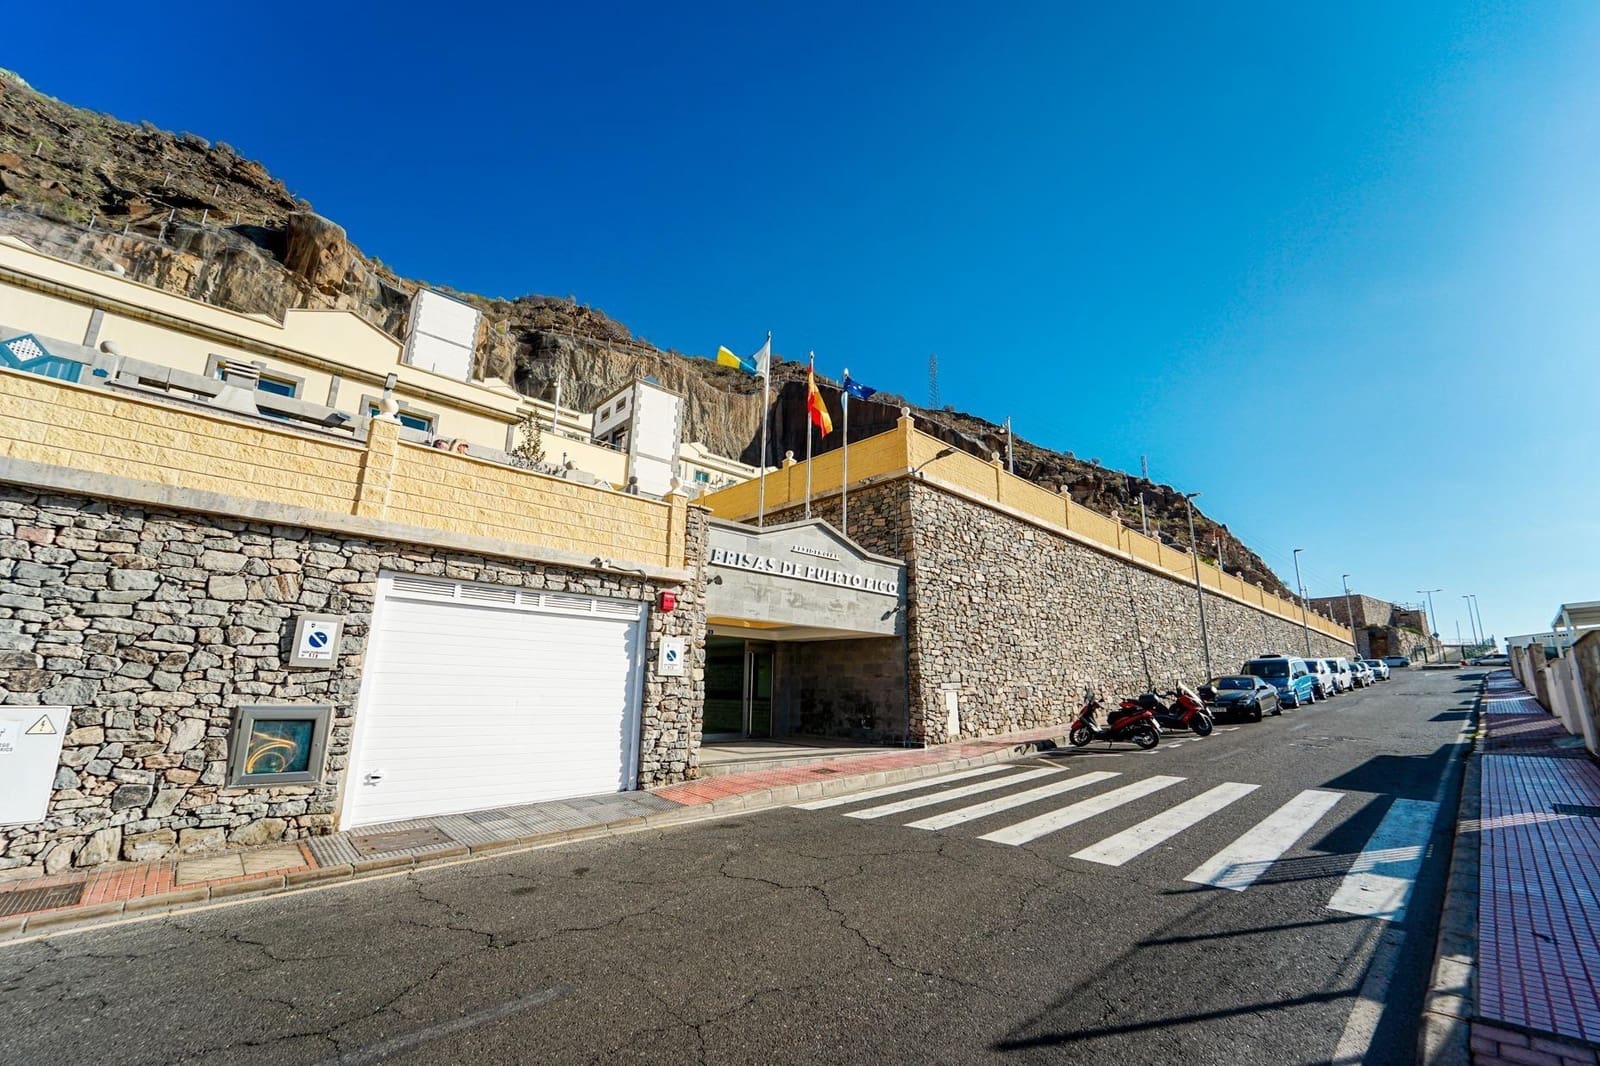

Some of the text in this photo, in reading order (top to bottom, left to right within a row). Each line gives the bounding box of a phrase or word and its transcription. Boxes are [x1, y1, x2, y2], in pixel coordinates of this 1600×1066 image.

[711, 547, 897, 594] BRISAS DE PUERTO RICO
